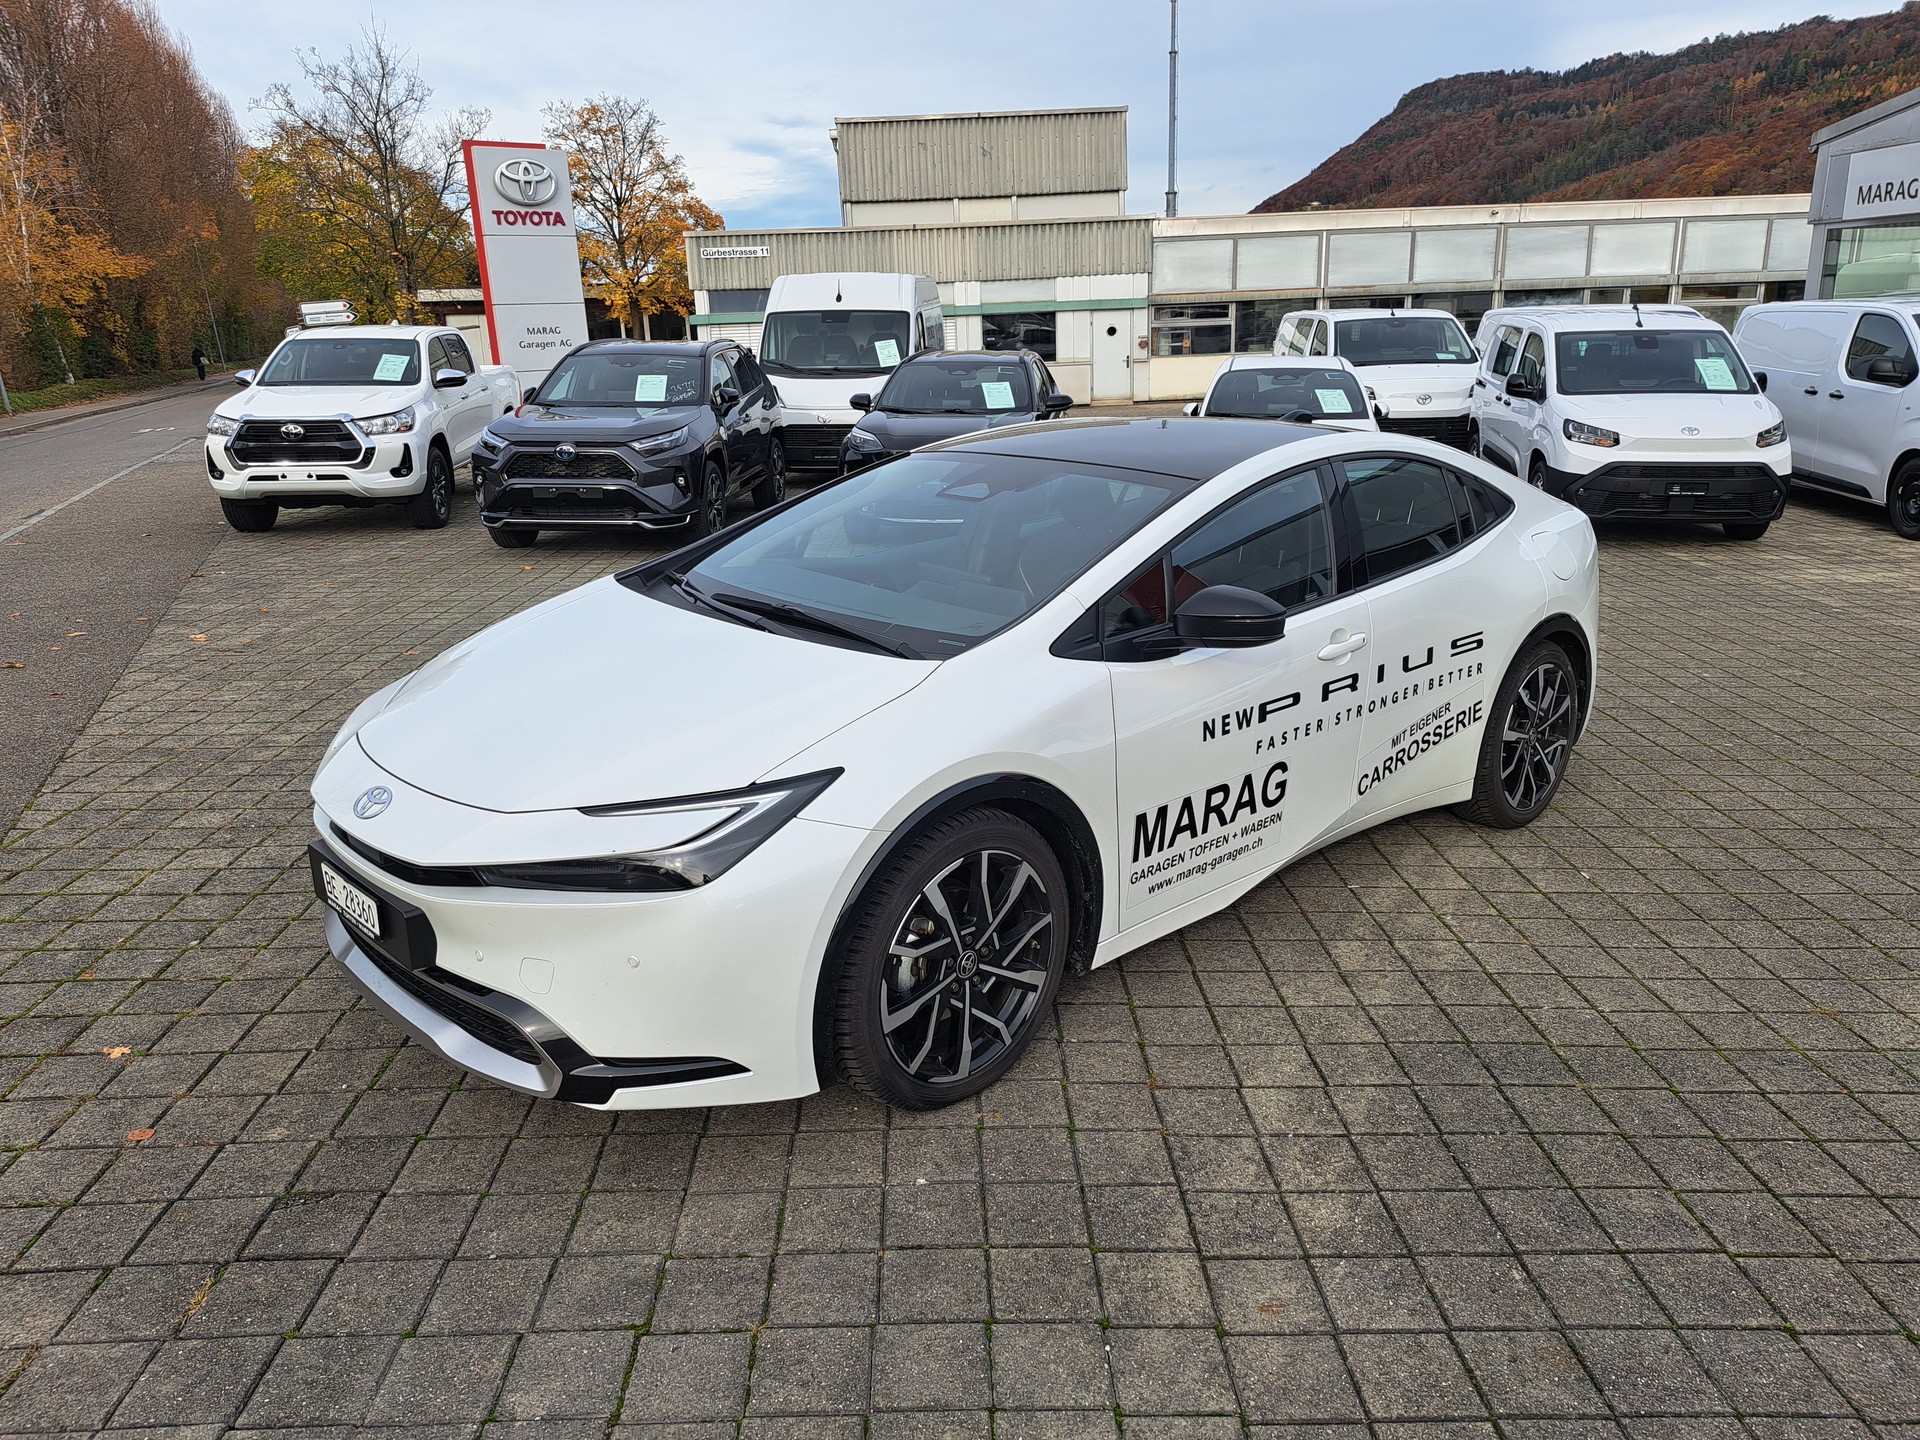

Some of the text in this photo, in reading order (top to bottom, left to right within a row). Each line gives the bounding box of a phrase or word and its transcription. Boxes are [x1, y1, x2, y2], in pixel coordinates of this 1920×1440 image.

[1857, 178, 1920, 205] MARAG
[491, 210, 566, 227] TOYOTA
[702, 247, 769, 257] Gürbestrasse 11
[519, 338, 572, 350] Garagen AG
[526, 326, 561, 335] MARAG
[1202, 631, 1484, 742] NEW PRIUS
[1256, 662, 1483, 754] FASTER STRONGER BETTER
[1357, 700, 1483, 796] CARROSSERIE
[1391, 702, 1451, 749] MIT EIGENER
[1132, 760, 1288, 863] MARAG
[1130, 851, 1185, 885] GARAGEN
[1188, 833, 1230, 859] TOFFEN
[1240, 811, 1283, 838] WABERN
[1148, 836, 1263, 895] www.marag-garagen.ch
